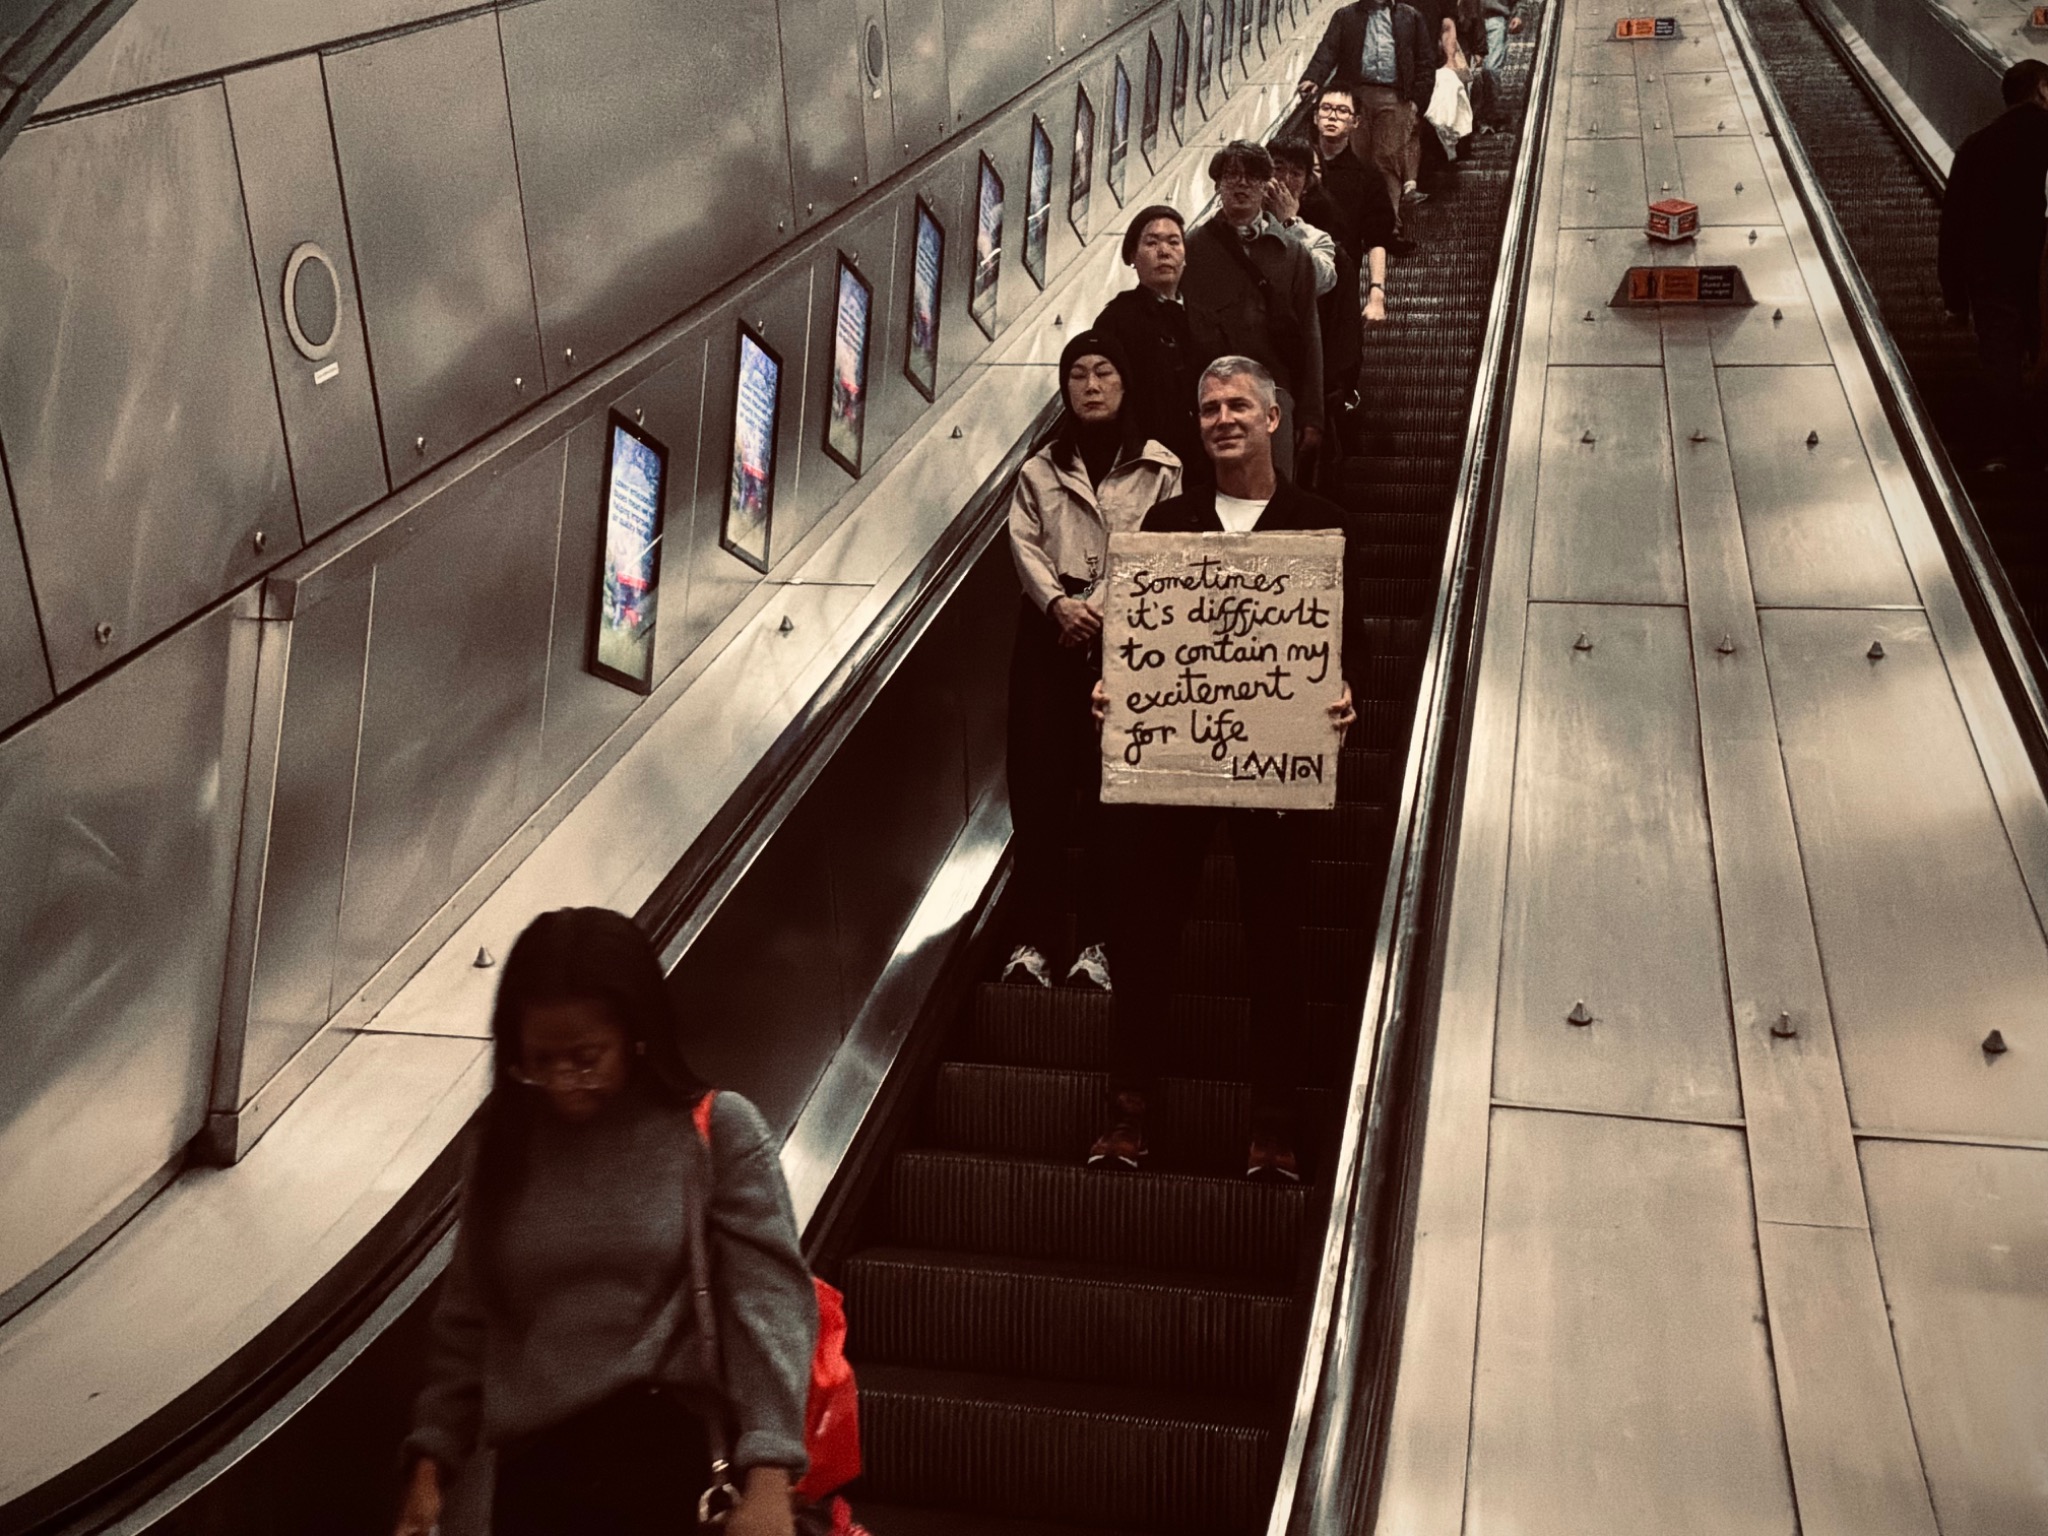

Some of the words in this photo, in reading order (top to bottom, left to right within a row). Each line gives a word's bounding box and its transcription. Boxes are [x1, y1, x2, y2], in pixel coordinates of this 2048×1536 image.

[1129, 555, 1290, 597] Sometimes
[1127, 597, 1174, 630] it's
[1187, 596, 1330, 637] difficult
[1120, 637, 1165, 671] to
[1175, 634, 1277, 665] contain
[1287, 641, 1330, 683] my
[1126, 665, 1295, 713] excitement
[1124, 721, 1177, 766] for
[1191, 709, 1248, 761] life
